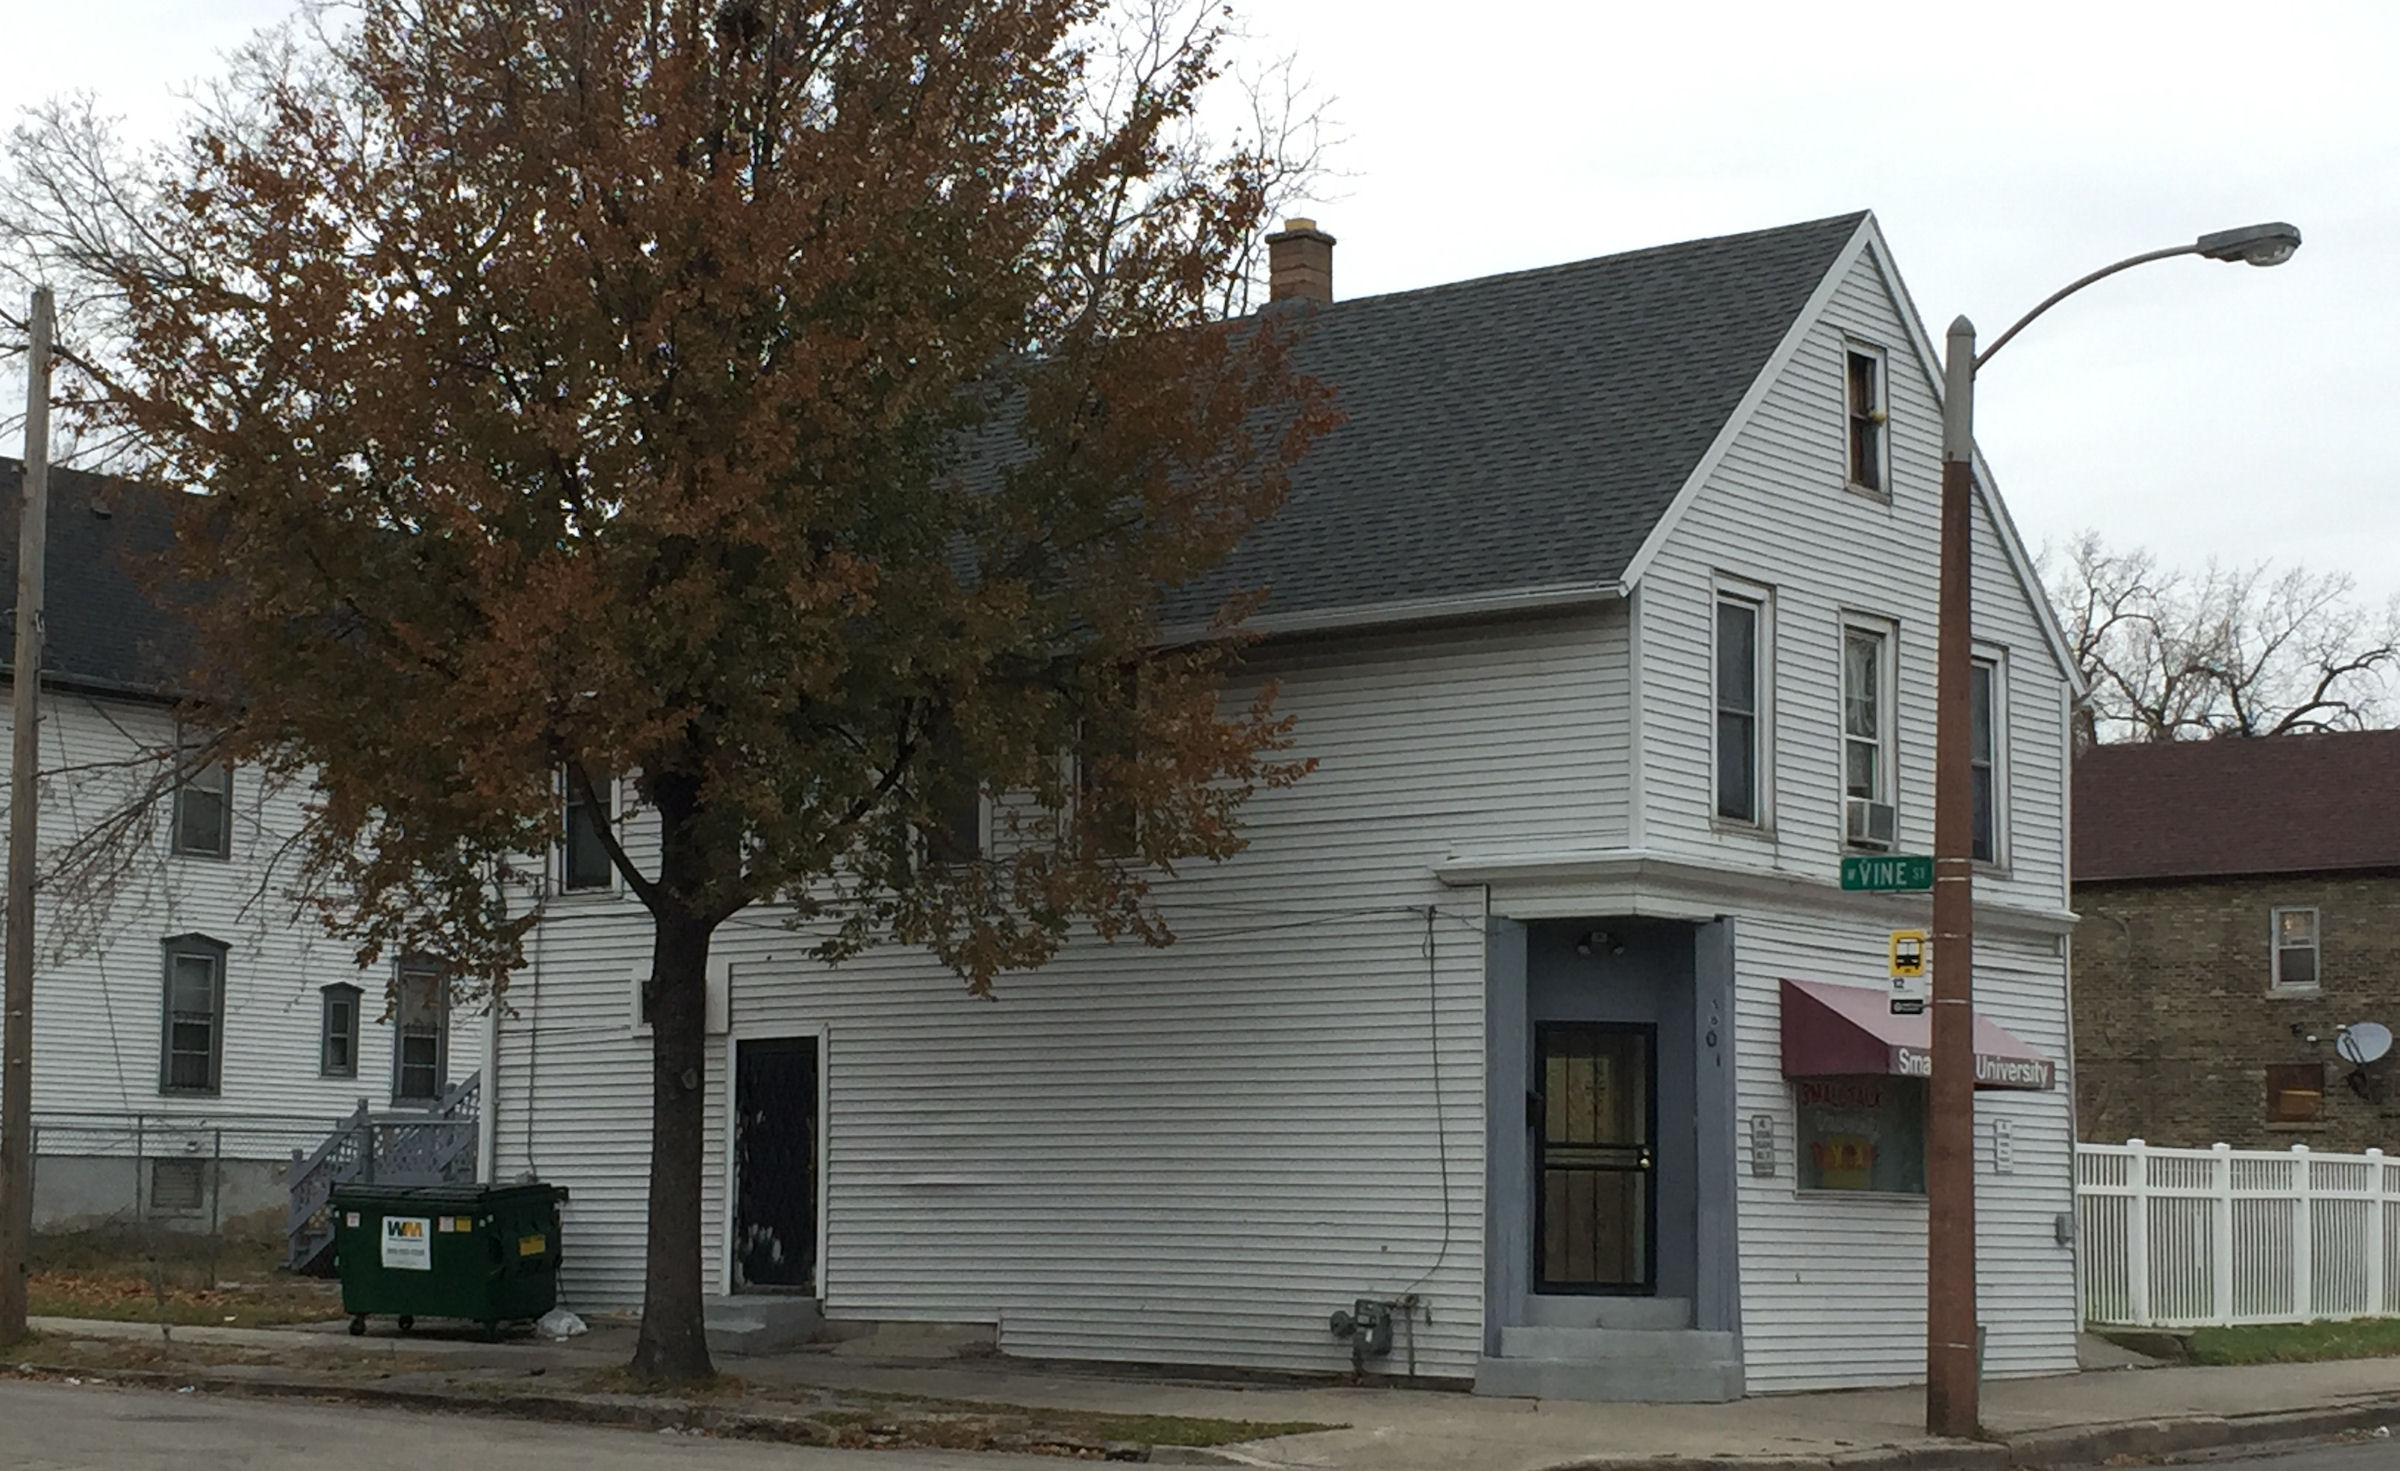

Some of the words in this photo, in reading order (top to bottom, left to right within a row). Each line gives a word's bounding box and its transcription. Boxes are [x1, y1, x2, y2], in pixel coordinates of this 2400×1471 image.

[1858, 862, 1907, 886] VINE
[1912, 866, 1925, 881] ST
[1899, 1047, 1932, 1077] Sma
[1975, 1055, 2049, 1088] University
[387, 1220, 424, 1237] WM
